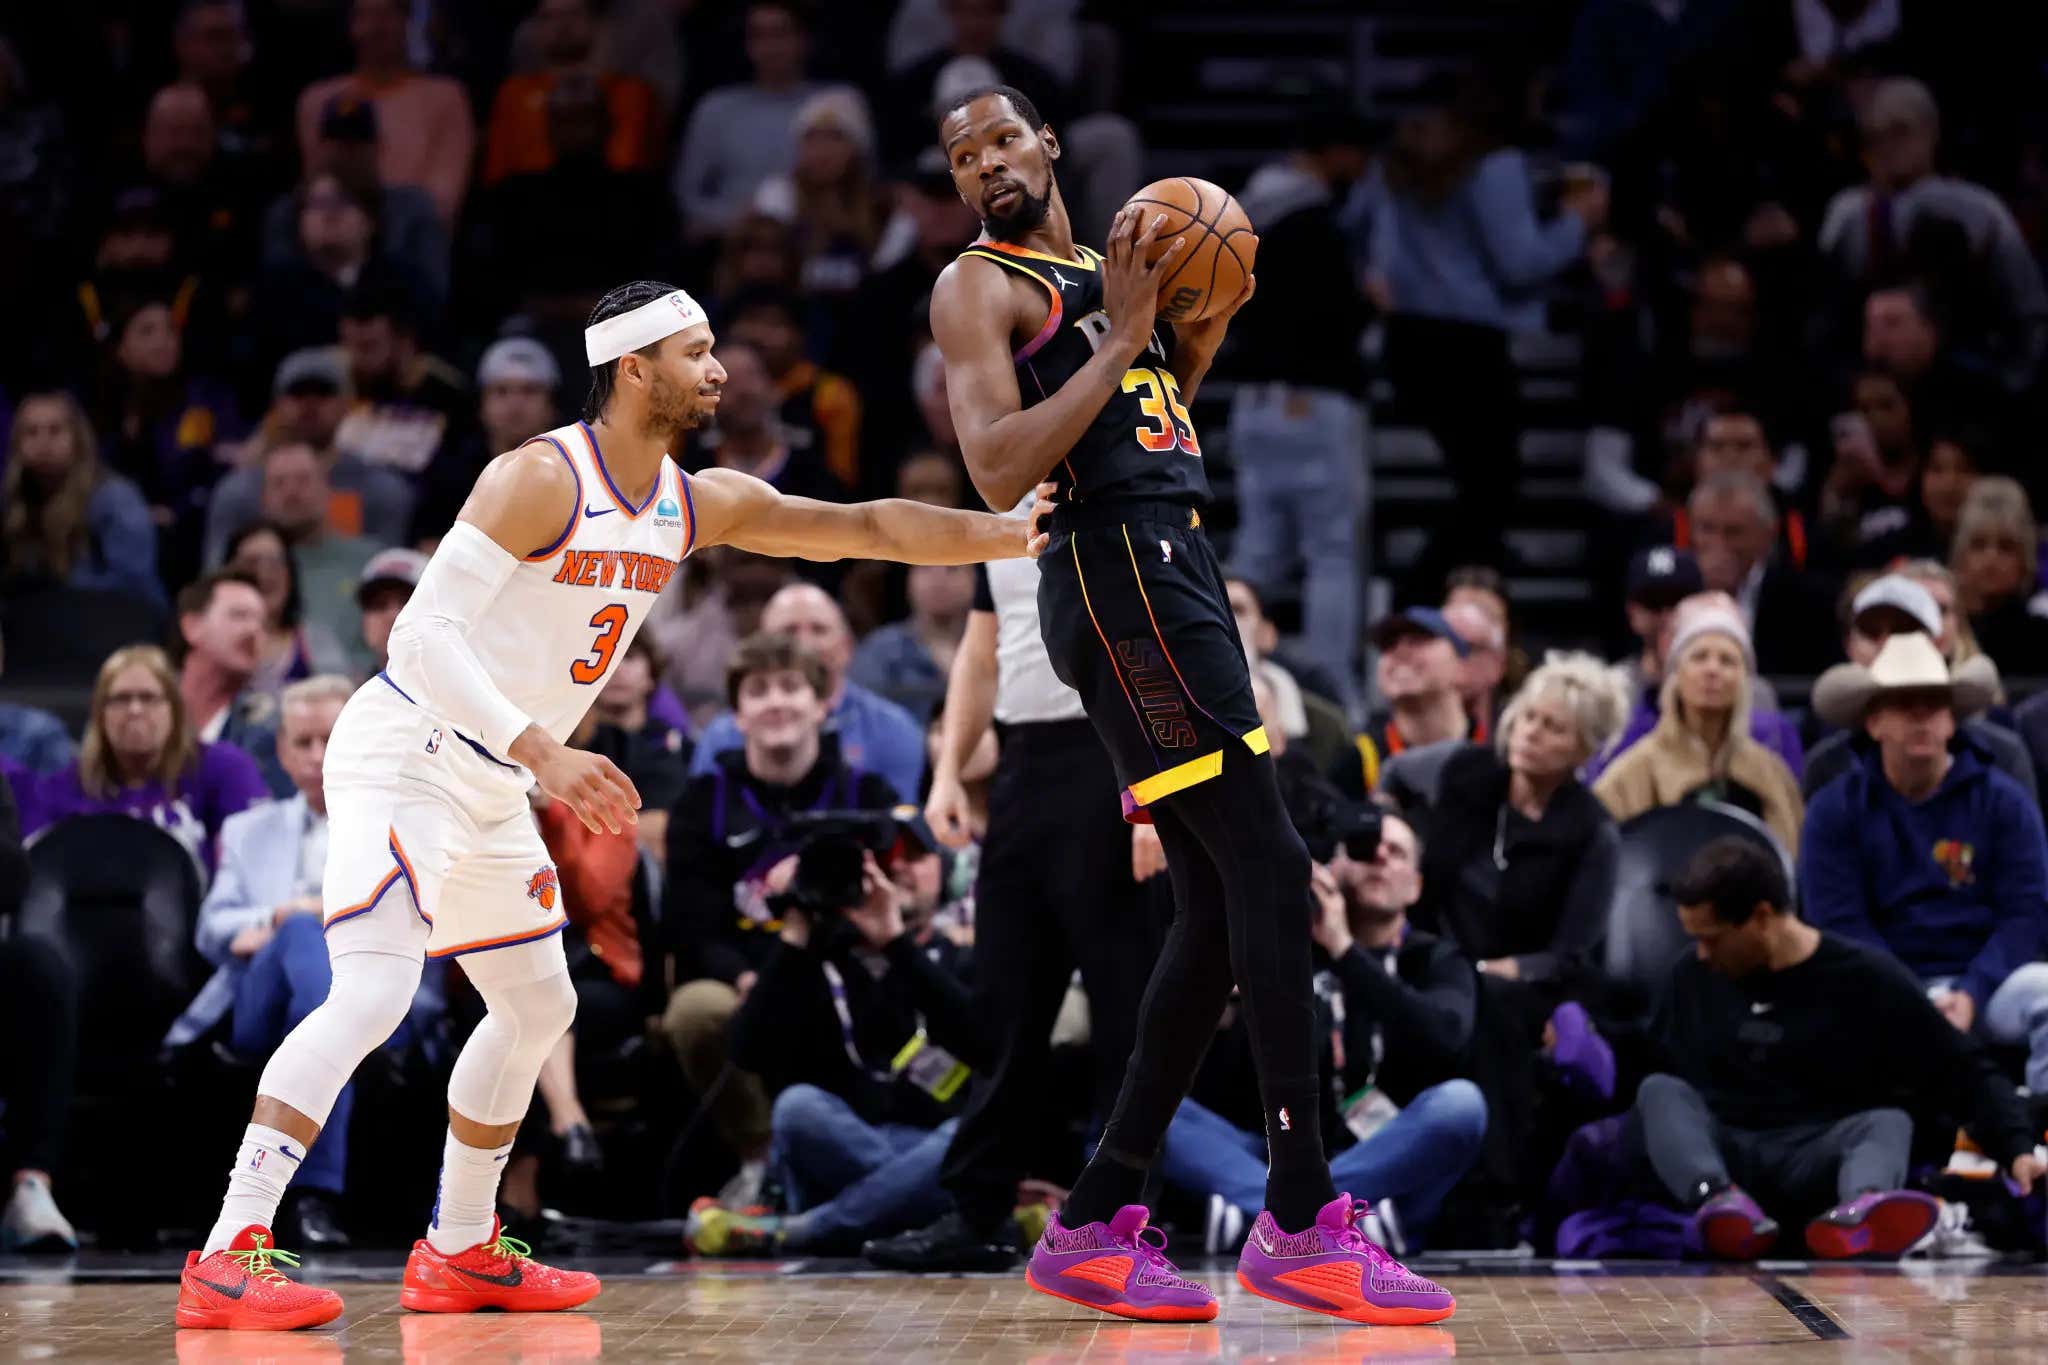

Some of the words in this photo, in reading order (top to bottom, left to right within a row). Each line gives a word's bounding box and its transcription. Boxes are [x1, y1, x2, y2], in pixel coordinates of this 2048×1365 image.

[1121, 367, 1201, 456] 35
[553, 550, 619, 587] NEW
[570, 603, 629, 684] 3
[1116, 638, 1197, 748] SUNS
